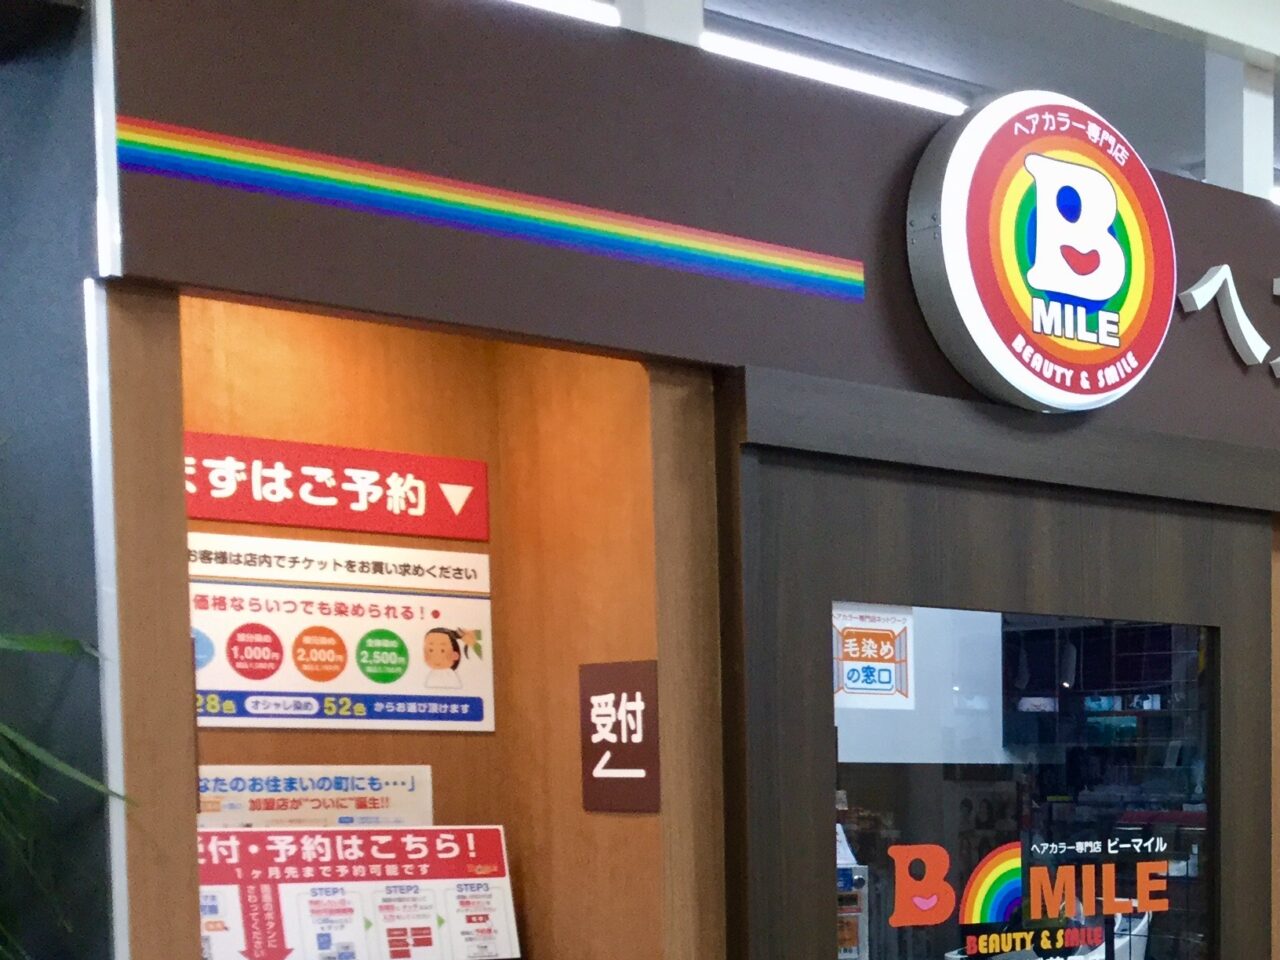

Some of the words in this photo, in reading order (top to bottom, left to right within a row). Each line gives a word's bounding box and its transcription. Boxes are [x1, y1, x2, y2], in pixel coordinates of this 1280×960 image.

[1014, 112, 1129, 166] ヘアカラー専門店
[1024, 153, 1126, 301] B
[1032, 297, 1120, 347] MILE
[1011, 334, 1073, 387] BEAUTY
[1079, 371, 1091, 389] &
[1097, 351, 1139, 386] SMILE
[231, 646, 280, 661] 1,000円
[297, 648, 344, 662] 2,000円
[360, 651, 406, 665] 2,500円
[843, 639, 895, 659] 毛染め
[846, 666, 892, 684] の窓口
[323, 697, 367, 716] 52色
[590, 691, 646, 743] 受付
[197, 833, 477, 866] 付・予約はこちら!
[1031, 841, 1102, 855] ヘアカラー専門店
[1107, 837, 1168, 853] ビーマイル
[310, 887, 345, 897] STEP1
[385, 885, 419, 895] STEP2
[456, 883, 490, 893] STEP3
[887, 844, 957, 928] B
[1029, 860, 1170, 921] MILE
[966, 931, 1034, 955] BEAUTY
[1041, 930, 1052, 950] &
[1055, 927, 1104, 947] SMILE
